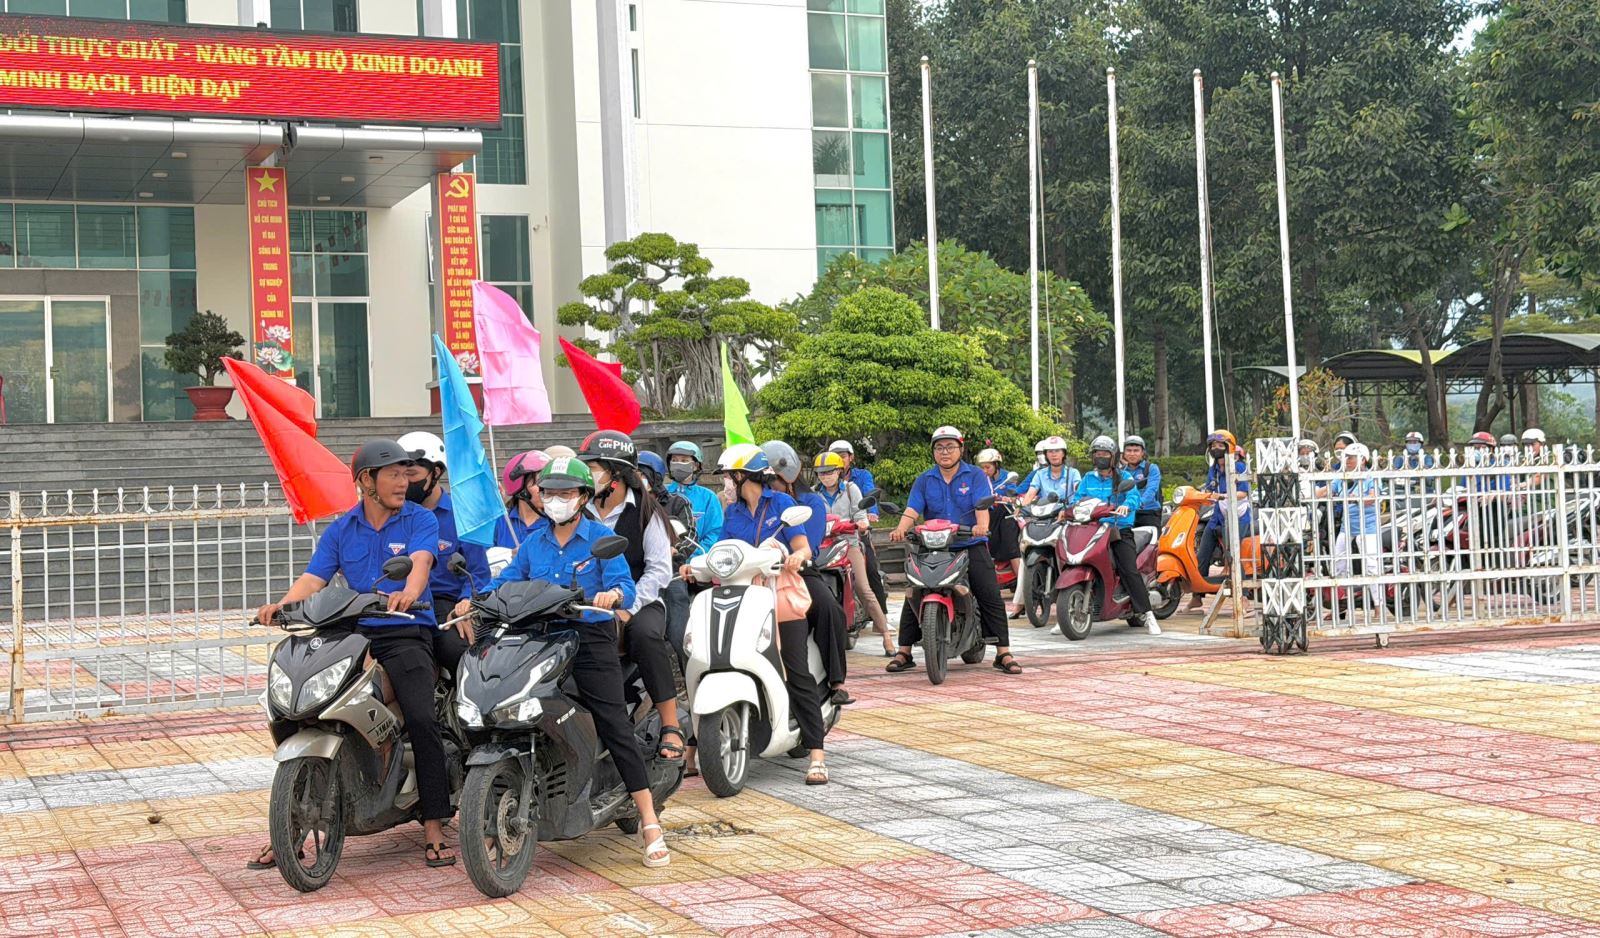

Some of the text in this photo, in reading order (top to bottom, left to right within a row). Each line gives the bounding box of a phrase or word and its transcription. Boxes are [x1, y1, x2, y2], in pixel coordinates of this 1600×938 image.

[43, 34, 111, 60] THỰC
[117, 38, 178, 60] CHẤT
[261, 45, 310, 68] TẦM
[315, 49, 347, 73] HỘ
[352, 53, 405, 73] KINH
[409, 57, 483, 77] DOANH
[0, 70, 250, 103] MINH BẠCH, HIỆN ĐẠI"
